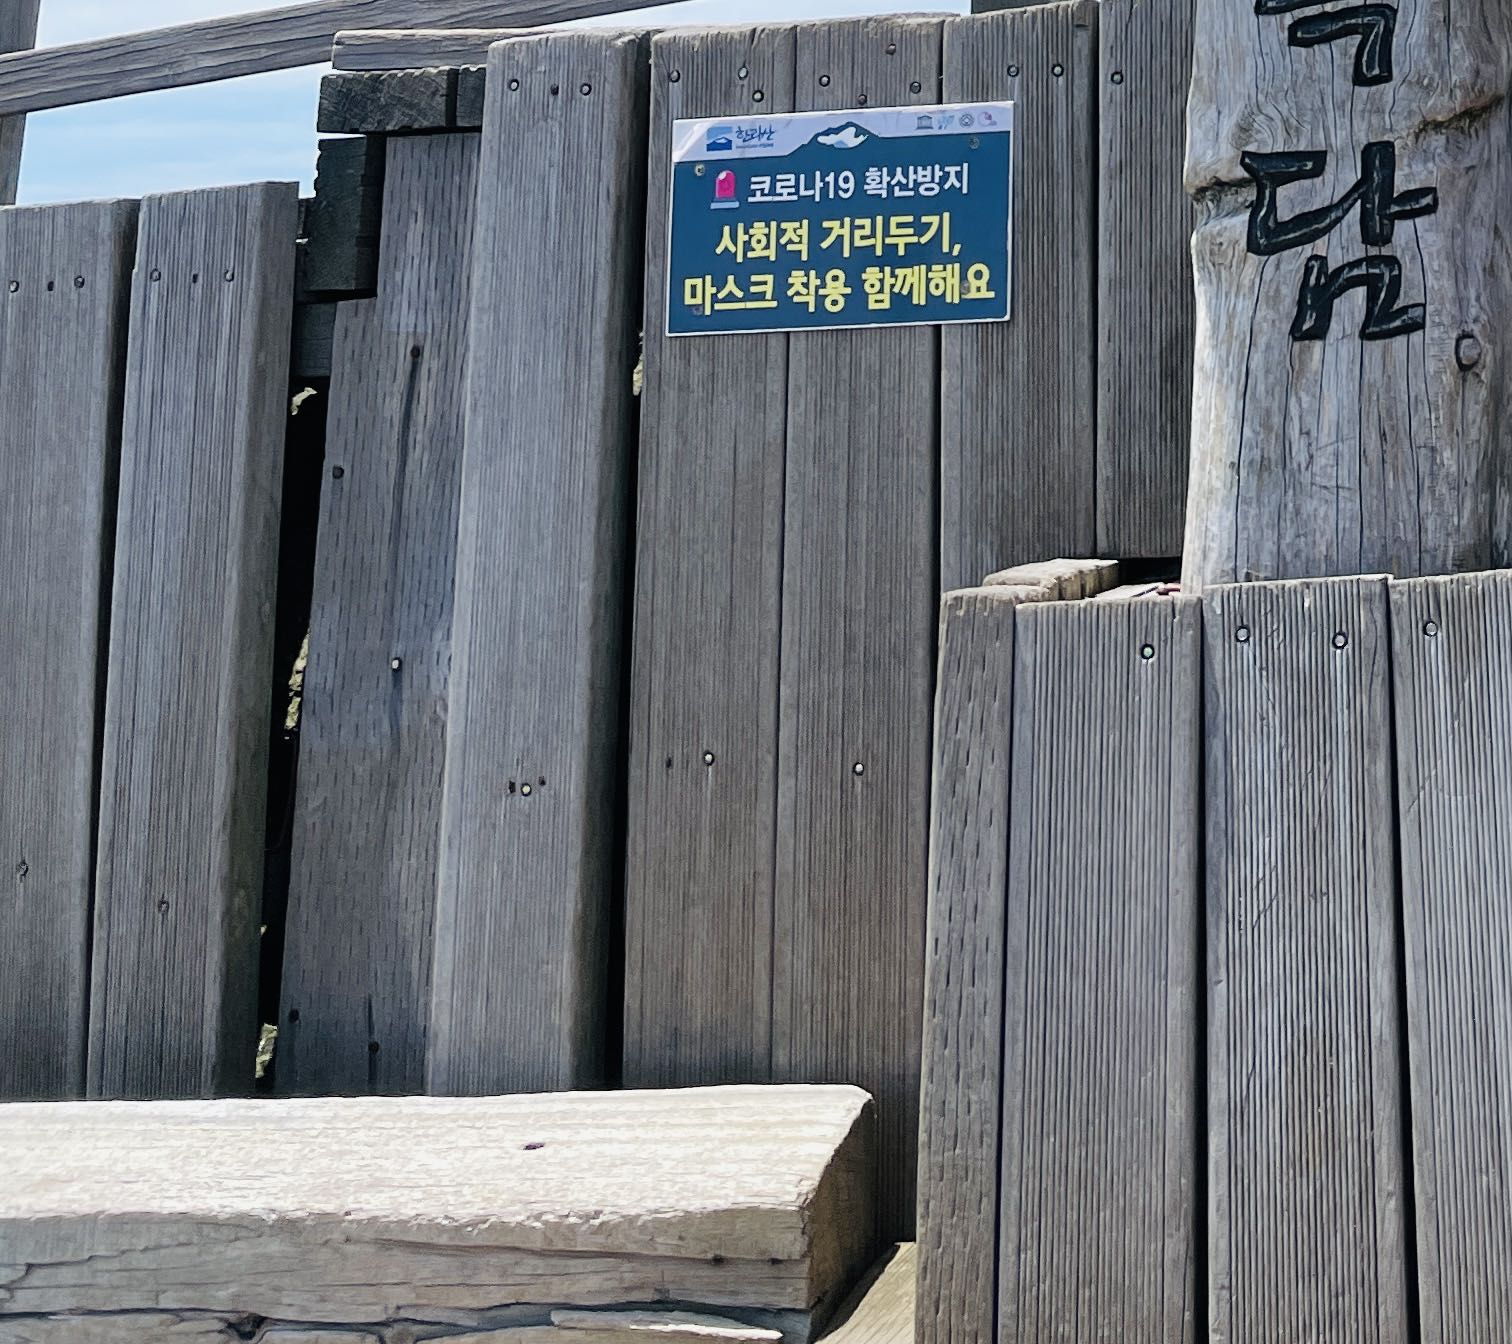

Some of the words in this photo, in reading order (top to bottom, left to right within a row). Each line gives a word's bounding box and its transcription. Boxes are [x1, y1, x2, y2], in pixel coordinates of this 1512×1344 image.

[747, 170, 855, 203] 코로나19
[863, 162, 969, 199] 확산방지
[715, 218, 809, 263] 사회적
[820, 211, 962, 257] 거리두기,
[683, 274, 778, 316] 마스크
[786, 268, 852, 313] 착용
[862, 262, 995, 311] 함께해요
